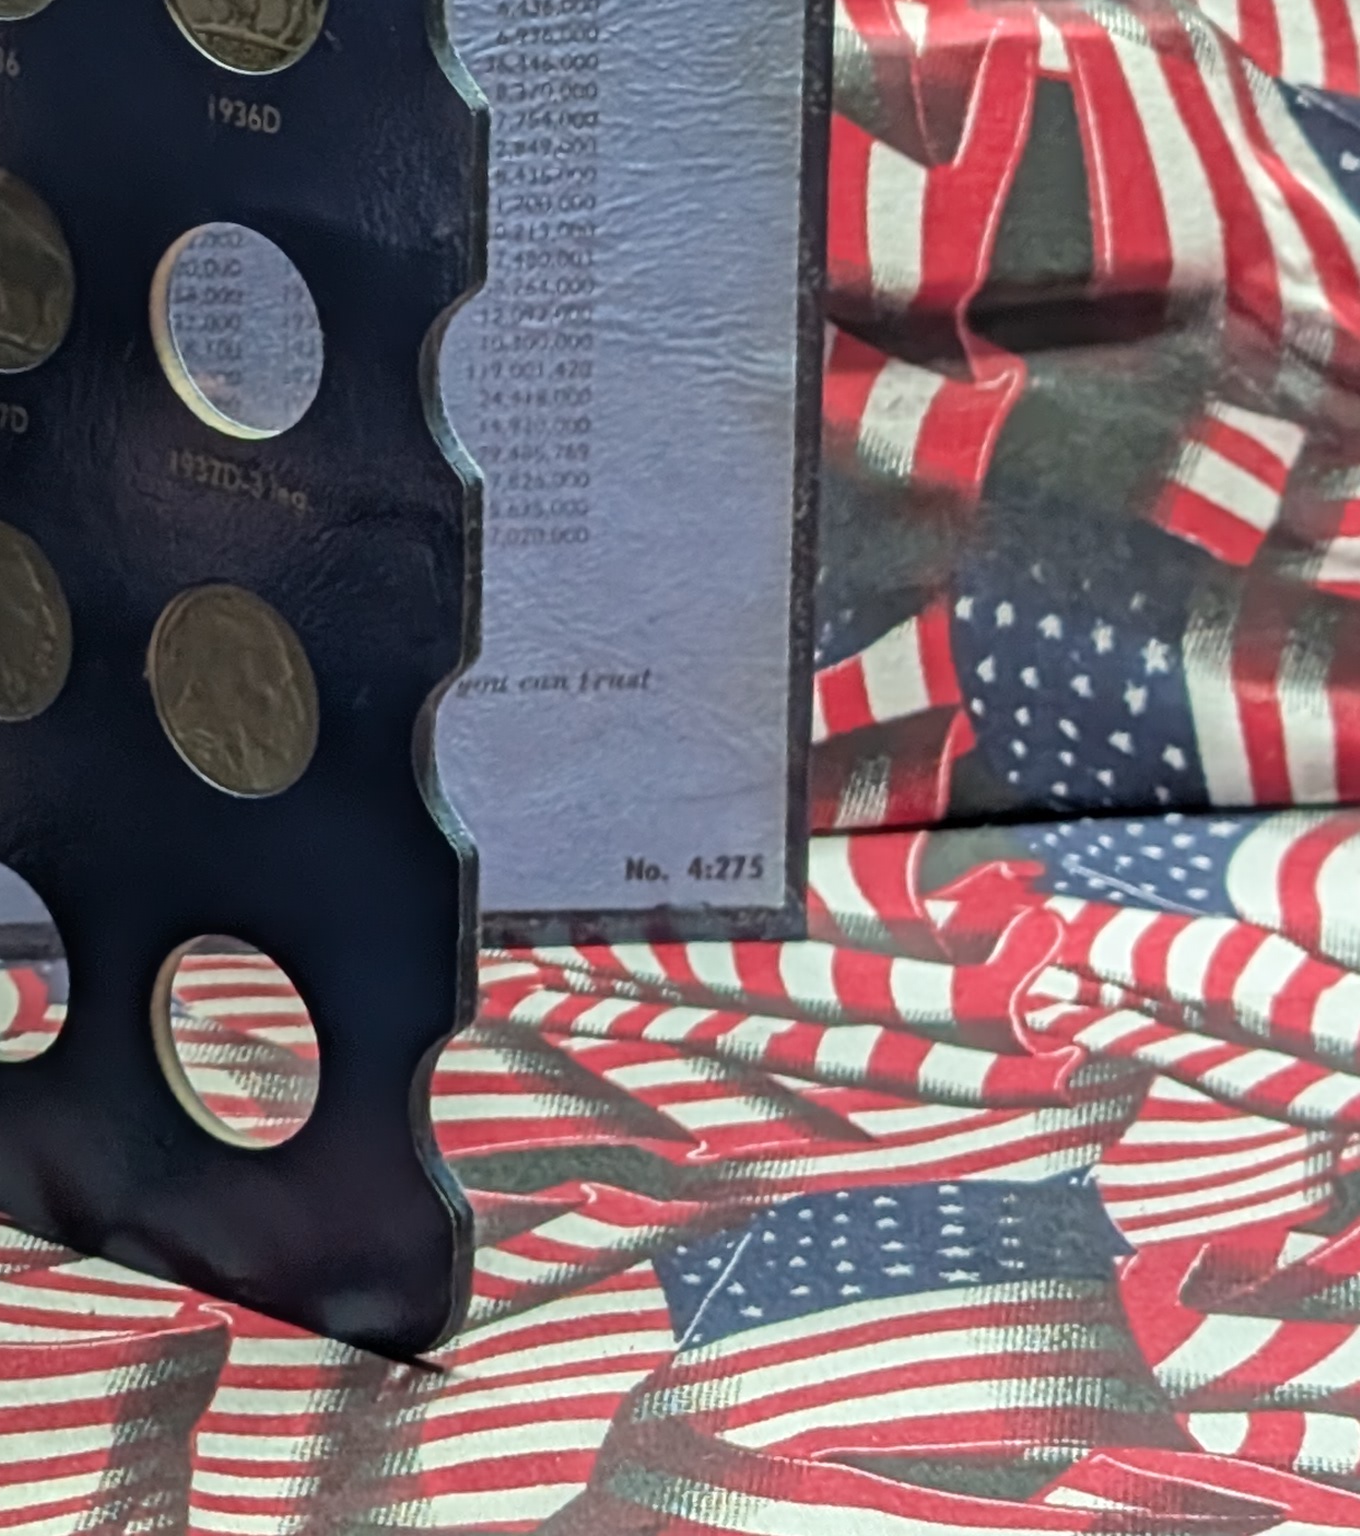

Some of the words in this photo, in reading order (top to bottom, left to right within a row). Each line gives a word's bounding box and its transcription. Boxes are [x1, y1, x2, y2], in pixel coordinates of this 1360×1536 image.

[208, 95, 280, 134] 1936D
[519, 676, 569, 693] can
[581, 668, 652, 692] trust
[625, 857, 669, 881] No.
[688, 855, 765, 880] 4:275
